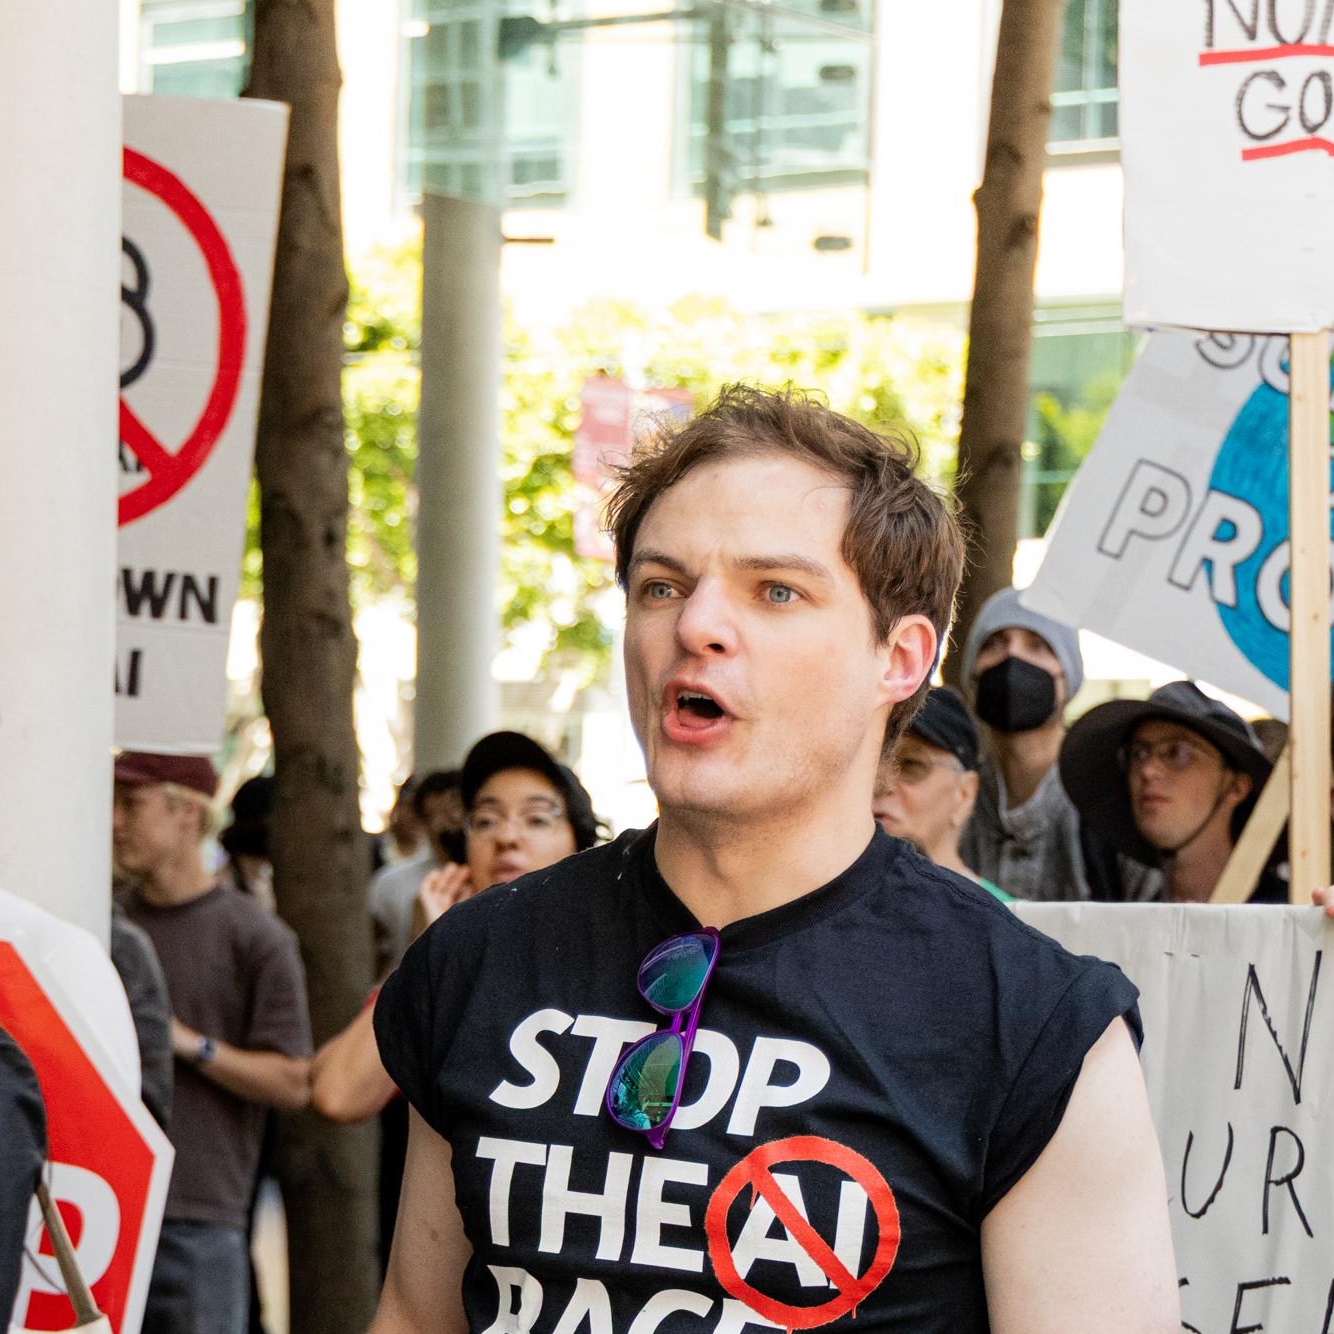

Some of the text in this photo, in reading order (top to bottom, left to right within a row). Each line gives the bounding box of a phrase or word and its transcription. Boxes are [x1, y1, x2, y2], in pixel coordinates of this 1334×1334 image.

[1235, 70, 1333, 141] GO
[117, 567, 219, 624] WN
[488, 1008, 832, 1137] STOP
[474, 1136, 869, 1290] THE AI
